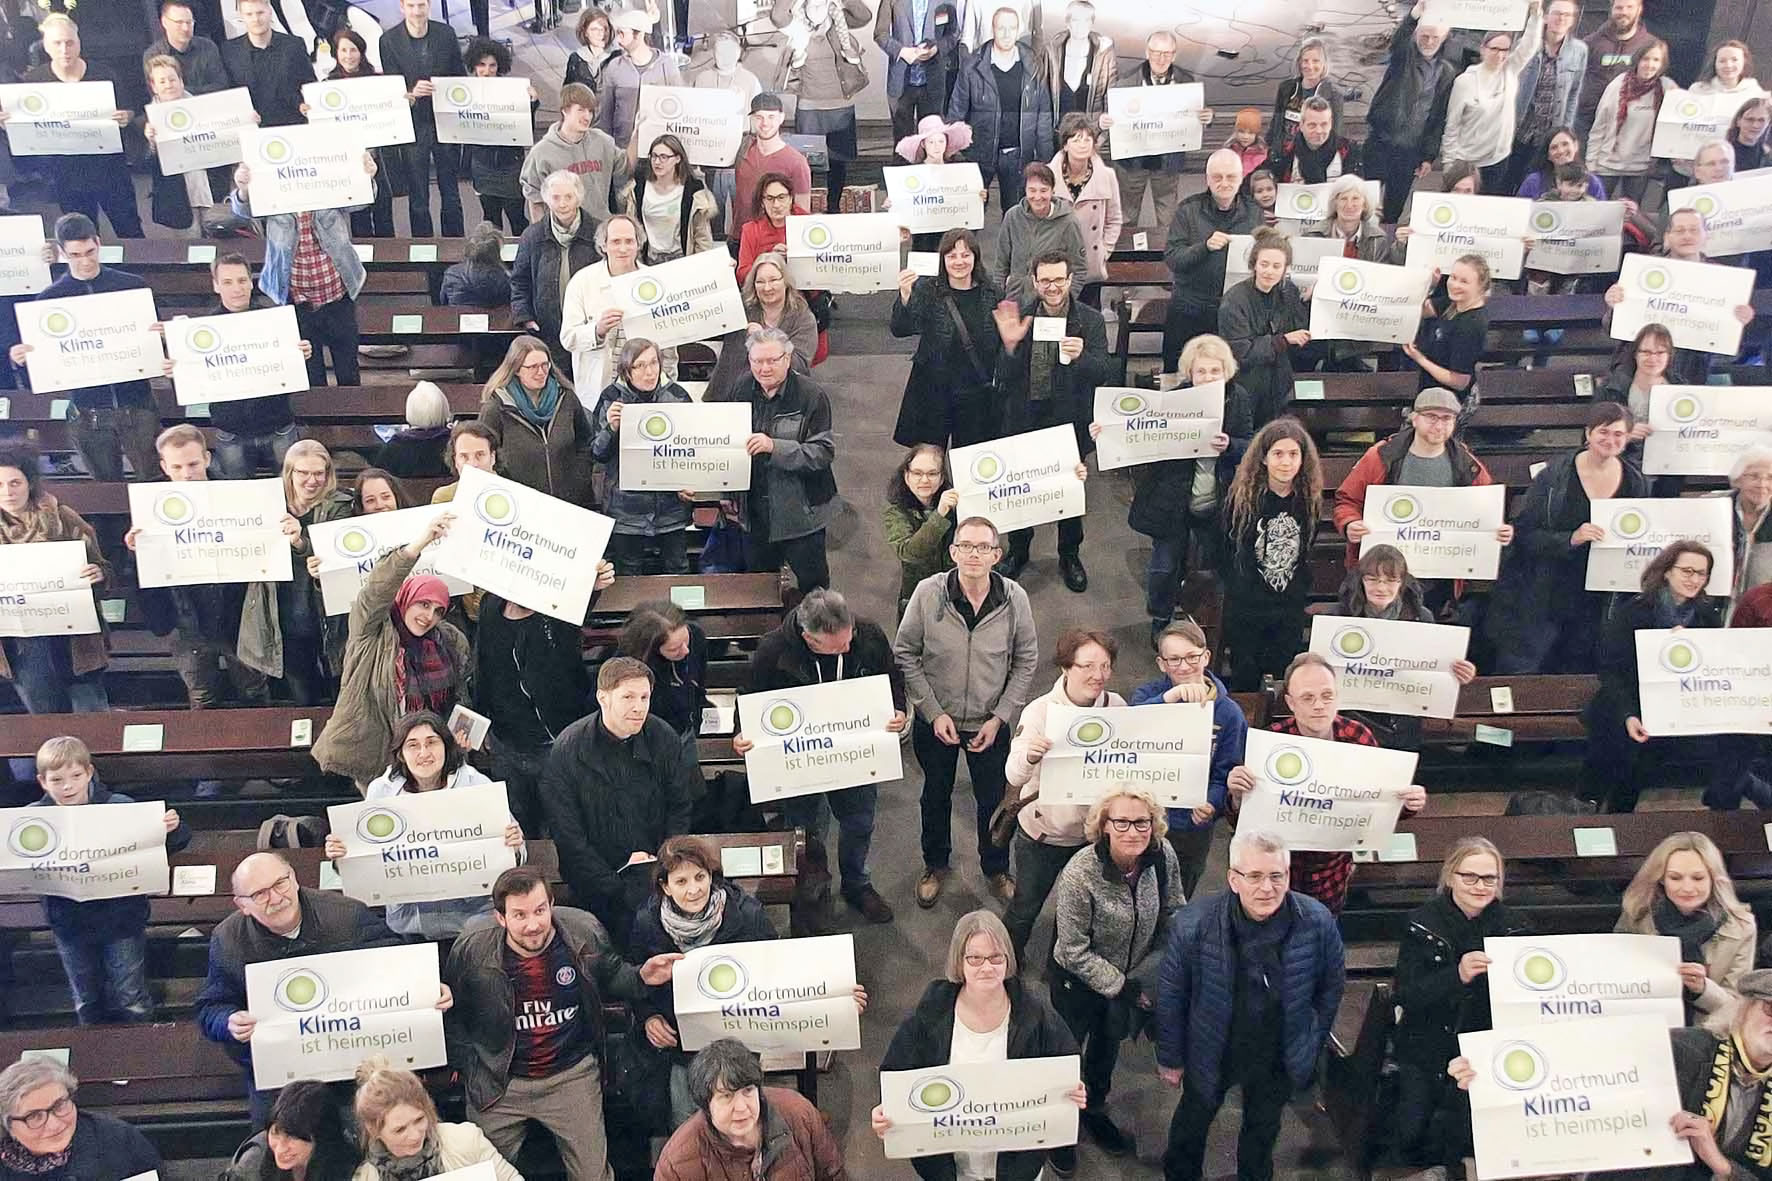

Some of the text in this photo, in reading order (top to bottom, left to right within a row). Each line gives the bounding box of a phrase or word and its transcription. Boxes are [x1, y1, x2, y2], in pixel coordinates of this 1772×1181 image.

[472, 102, 515, 112] dortmund
[457, 109, 490, 121] Klima
[682, 113, 727, 126] dortmund
[34, 119, 72, 130] Klima
[459, 120, 517, 131] ist heimspiel
[666, 121, 700, 135] Klima
[1132, 119, 1164, 131] Klima
[52, 128, 104, 139] heimspiel
[182, 130, 217, 144] Klima
[293, 152, 348, 166] dortmund
[277, 166, 318, 180] Klima
[279, 177, 352, 193] ist heimspiel
[926, 183, 969, 195] dortmund
[913, 193, 945, 206] Klima
[926, 203, 969, 217] heimspiel
[1456, 223, 1507, 236] dortmund
[1437, 231, 1475, 245] Klima
[832, 241, 882, 252] dortmund
[1434, 246, 1448, 256] ist
[815, 252, 853, 264] Klima
[816, 263, 882, 275] ist heimspiel
[666, 280, 718, 304] dortmund
[1360, 291, 1409, 304] dortmund
[650, 300, 690, 319] Klima
[1340, 299, 1378, 314] Klima
[1647, 296, 1688, 314] Klima
[653, 304, 724, 330] ist heimspiel
[1335, 310, 1403, 327] ist heimspiel
[79, 321, 136, 338] dortmund
[60, 338, 104, 353] Klima
[80, 345, 142, 365] heimspiel
[204, 352, 248, 368] Klima
[224, 361, 285, 378] heimspiel
[1145, 409, 1203, 418] dortmund
[1126, 418, 1168, 431] Klima
[1700, 416, 1758, 428] dortmund
[673, 434, 730, 446] dortmund
[1125, 430, 1201, 444] ist heimspiel
[1678, 426, 1719, 439] Klima
[653, 444, 696, 458] Klima
[652, 458, 729, 472] ist heimspiel
[1006, 461, 1060, 483] dortmund
[988, 482, 1031, 500] Klima
[989, 489, 1063, 513] ist heimspiel
[197, 514, 263, 528] dortmund
[1418, 517, 1480, 529] dortmund
[174, 529, 224, 544] Klima
[511, 524, 577, 559] dortmund
[1396, 527, 1441, 541] Klima
[484, 528, 533, 560] Klima
[1414, 542, 1477, 558] heimspiel
[1626, 543, 1664, 557] Klim
[177, 544, 266, 560] ist heimspiel
[480, 547, 567, 592] ist heimspiel
[1624, 558, 1639, 569] ist
[2, 604, 70, 618] heimspiel
[1370, 653, 1438, 669] dortmund
[1344, 661, 1394, 678] Klima
[1702, 664, 1771, 677] dortmund
[1342, 677, 1433, 696] ist heimspiel
[1679, 677, 1732, 692] Klima
[1681, 694, 1696, 707] ist
[803, 714, 870, 736] dortmund
[783, 736, 833, 755] Klima
[1110, 738, 1183, 751] dortmund
[785, 743, 875, 771] ist heimspiel
[1084, 750, 1137, 765] Klima
[1082, 766, 1181, 783] ist heimspiel
[1307, 779, 1381, 799] dortmund
[1279, 789, 1333, 811] Klima
[1276, 810, 1372, 829] ist heimspiel
[406, 824, 483, 844] dortmund
[58, 841, 137, 861] dortmund
[381, 843, 439, 863] Klima
[32, 861, 90, 873] Klima
[58, 864, 139, 883] heimspiel
[384, 854, 487, 879] ist heimspiel
[747, 981, 826, 1002] dortmund
[1567, 978, 1651, 995] dortmund
[328, 991, 409, 1014] dortmund
[523, 1000, 552, 1014] Fly
[721, 1003, 780, 1017] Klima
[1540, 995, 1602, 1015] Klima
[299, 1015, 361, 1035] Klima
[723, 1014, 829, 1032] ist heimspiel
[301, 1027, 412, 1055] ist heimspiel
[1551, 1066, 1639, 1091] dortmund
[962, 1093, 1047, 1115] dortmund
[1524, 1094, 1590, 1117] Klima
[933, 1114, 997, 1128] Klima
[1525, 1110, 1648, 1140] ist heimspiel
[933, 1119, 1047, 1139] ist heimspiel
